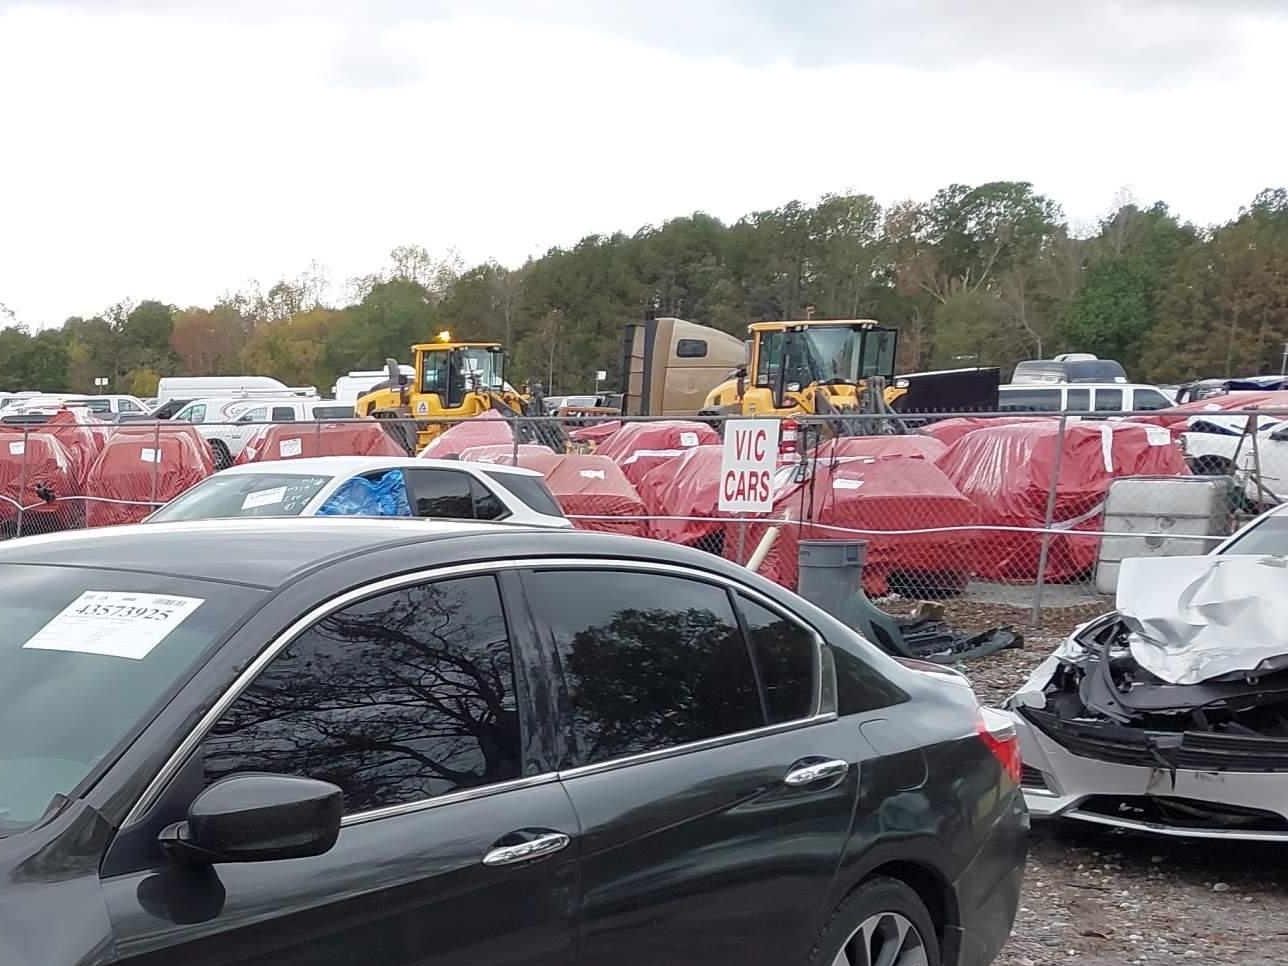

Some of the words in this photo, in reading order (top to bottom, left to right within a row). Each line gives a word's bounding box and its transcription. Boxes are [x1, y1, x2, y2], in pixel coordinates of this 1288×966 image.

[735, 429, 767, 461] VIC
[724, 470, 770, 502] CARS
[75, 604, 174, 621] 43573925
